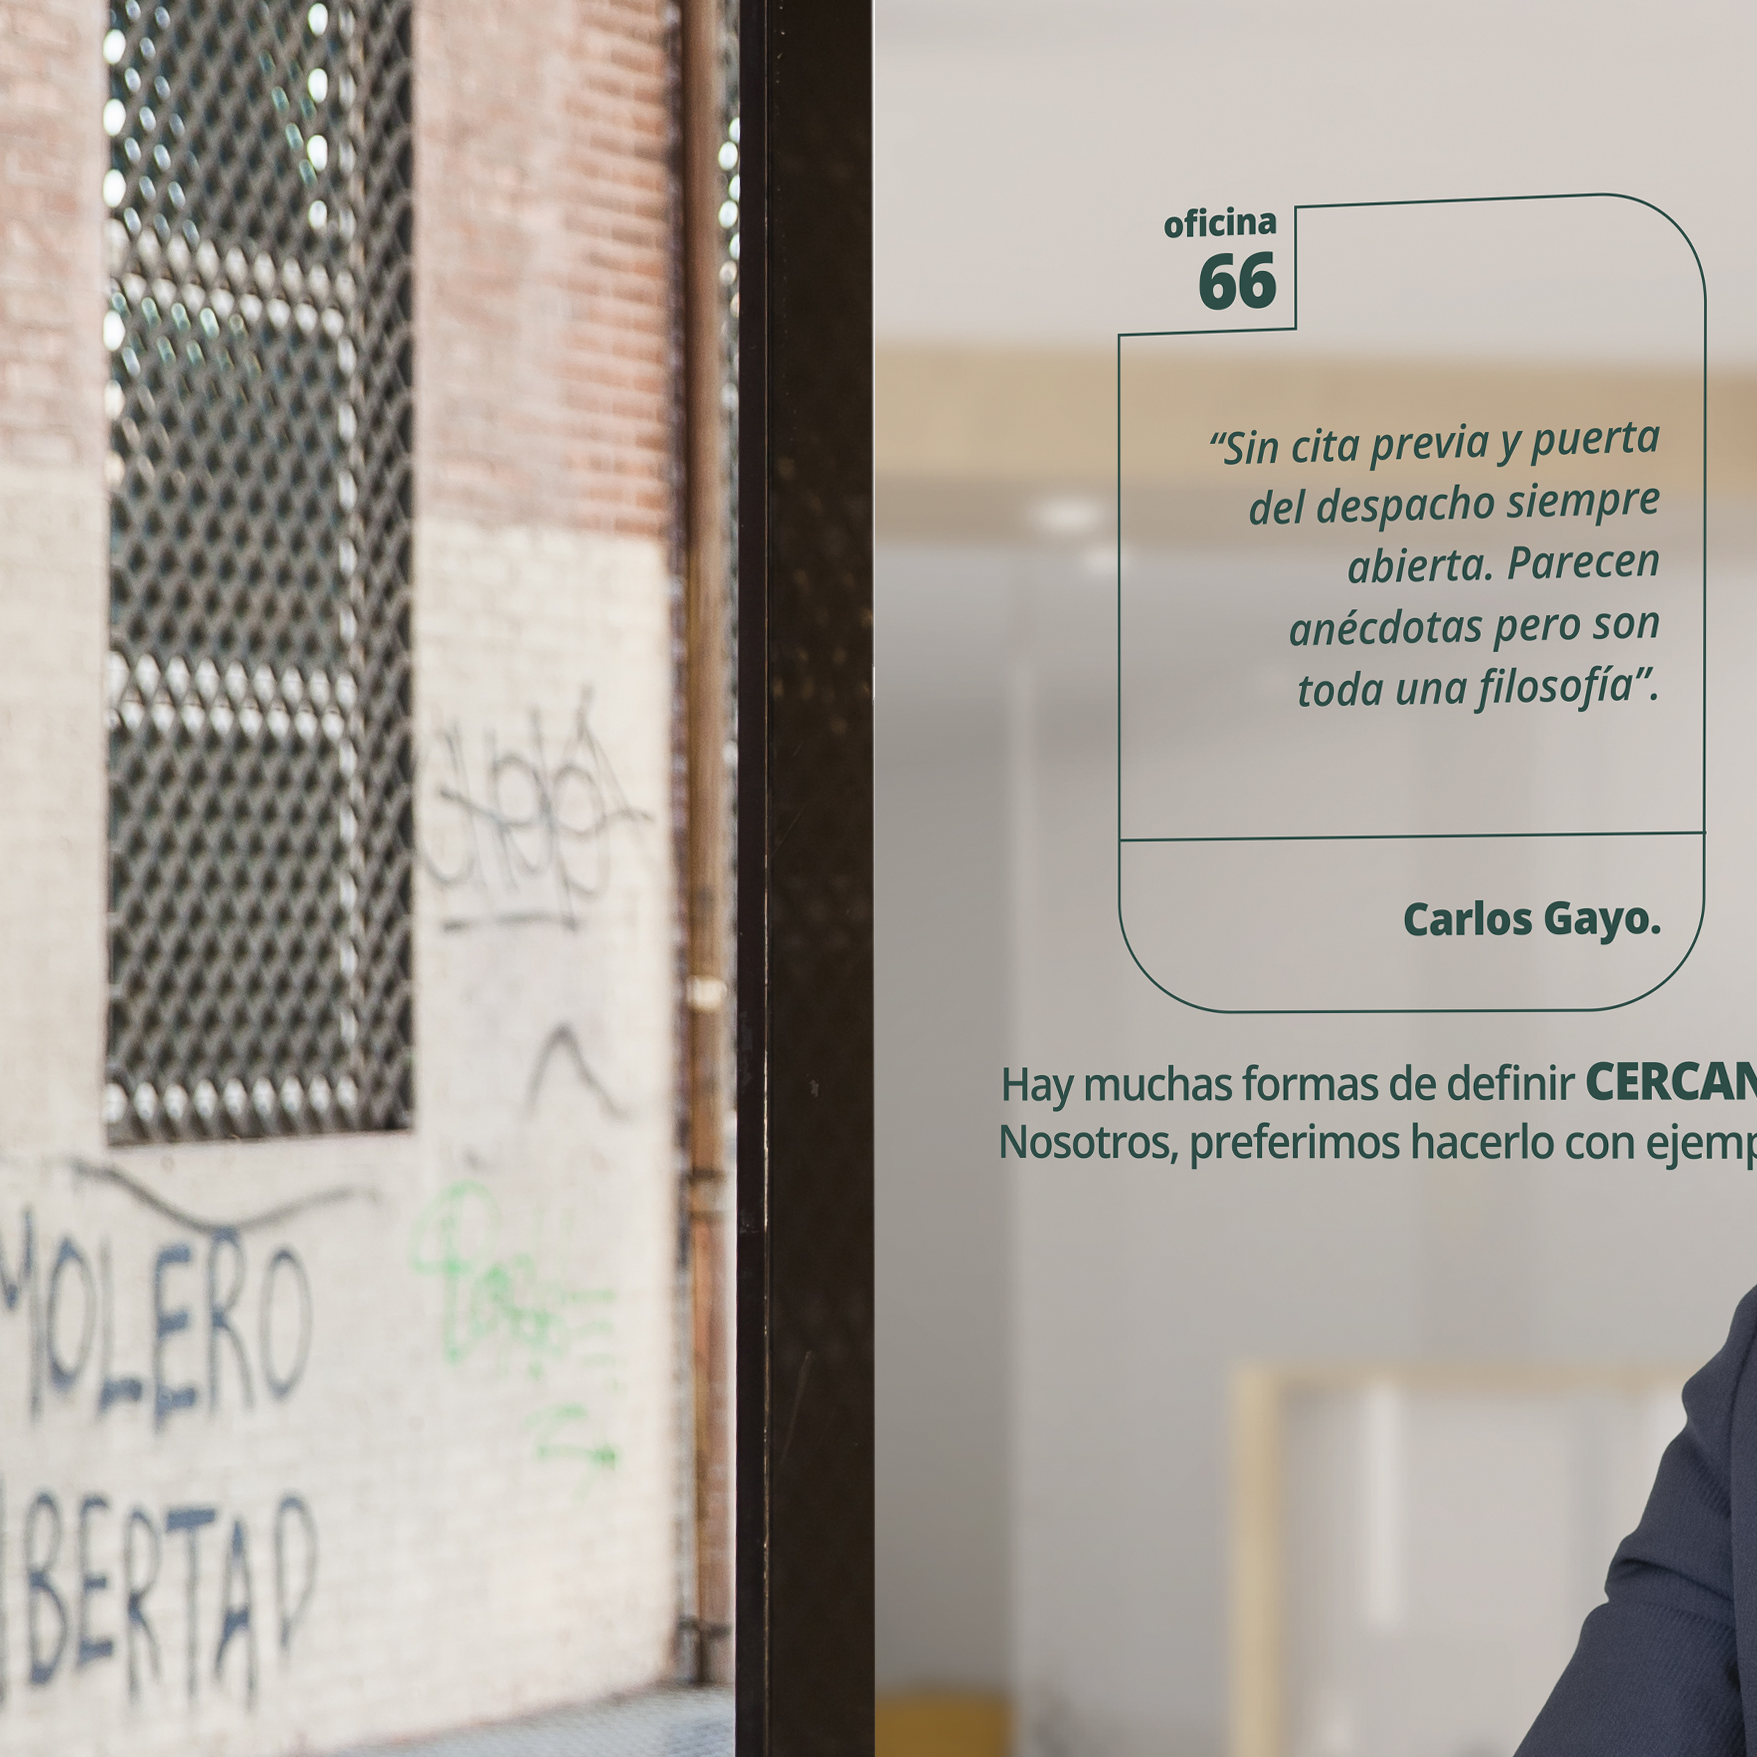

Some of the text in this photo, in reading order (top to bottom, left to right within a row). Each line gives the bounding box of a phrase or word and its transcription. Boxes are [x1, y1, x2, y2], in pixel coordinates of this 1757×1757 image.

[1164, 206, 1277, 239] oficina
[1199, 251, 1277, 311] 66
[1209, 421, 1661, 472] “Sin cita previa y puerta
[1249, 482, 1660, 533] del despacho siempre
[1348, 545, 1660, 584] abierta. Parecen
[1289, 608, 1660, 653] anécdotas pero son
[1298, 664, 1658, 715] toda una filosofía”.
[1404, 899, 1661, 946] Carlos Gayo.
[1003, 1066, 1075, 1113] Hay
[1085, 1064, 1233, 1102] muchas
[1241, 1064, 1379, 1102] formas
[1389, 1063, 1437, 1101] de
[1447, 1063, 1576, 1101] definir
[1000, 1124, 1179, 1165] Nosotros,
[1191, 1121, 1400, 1170] preferimos
[1412, 1122, 1555, 1160] hacerlo
[1565, 1131, 1635, 1160] con
